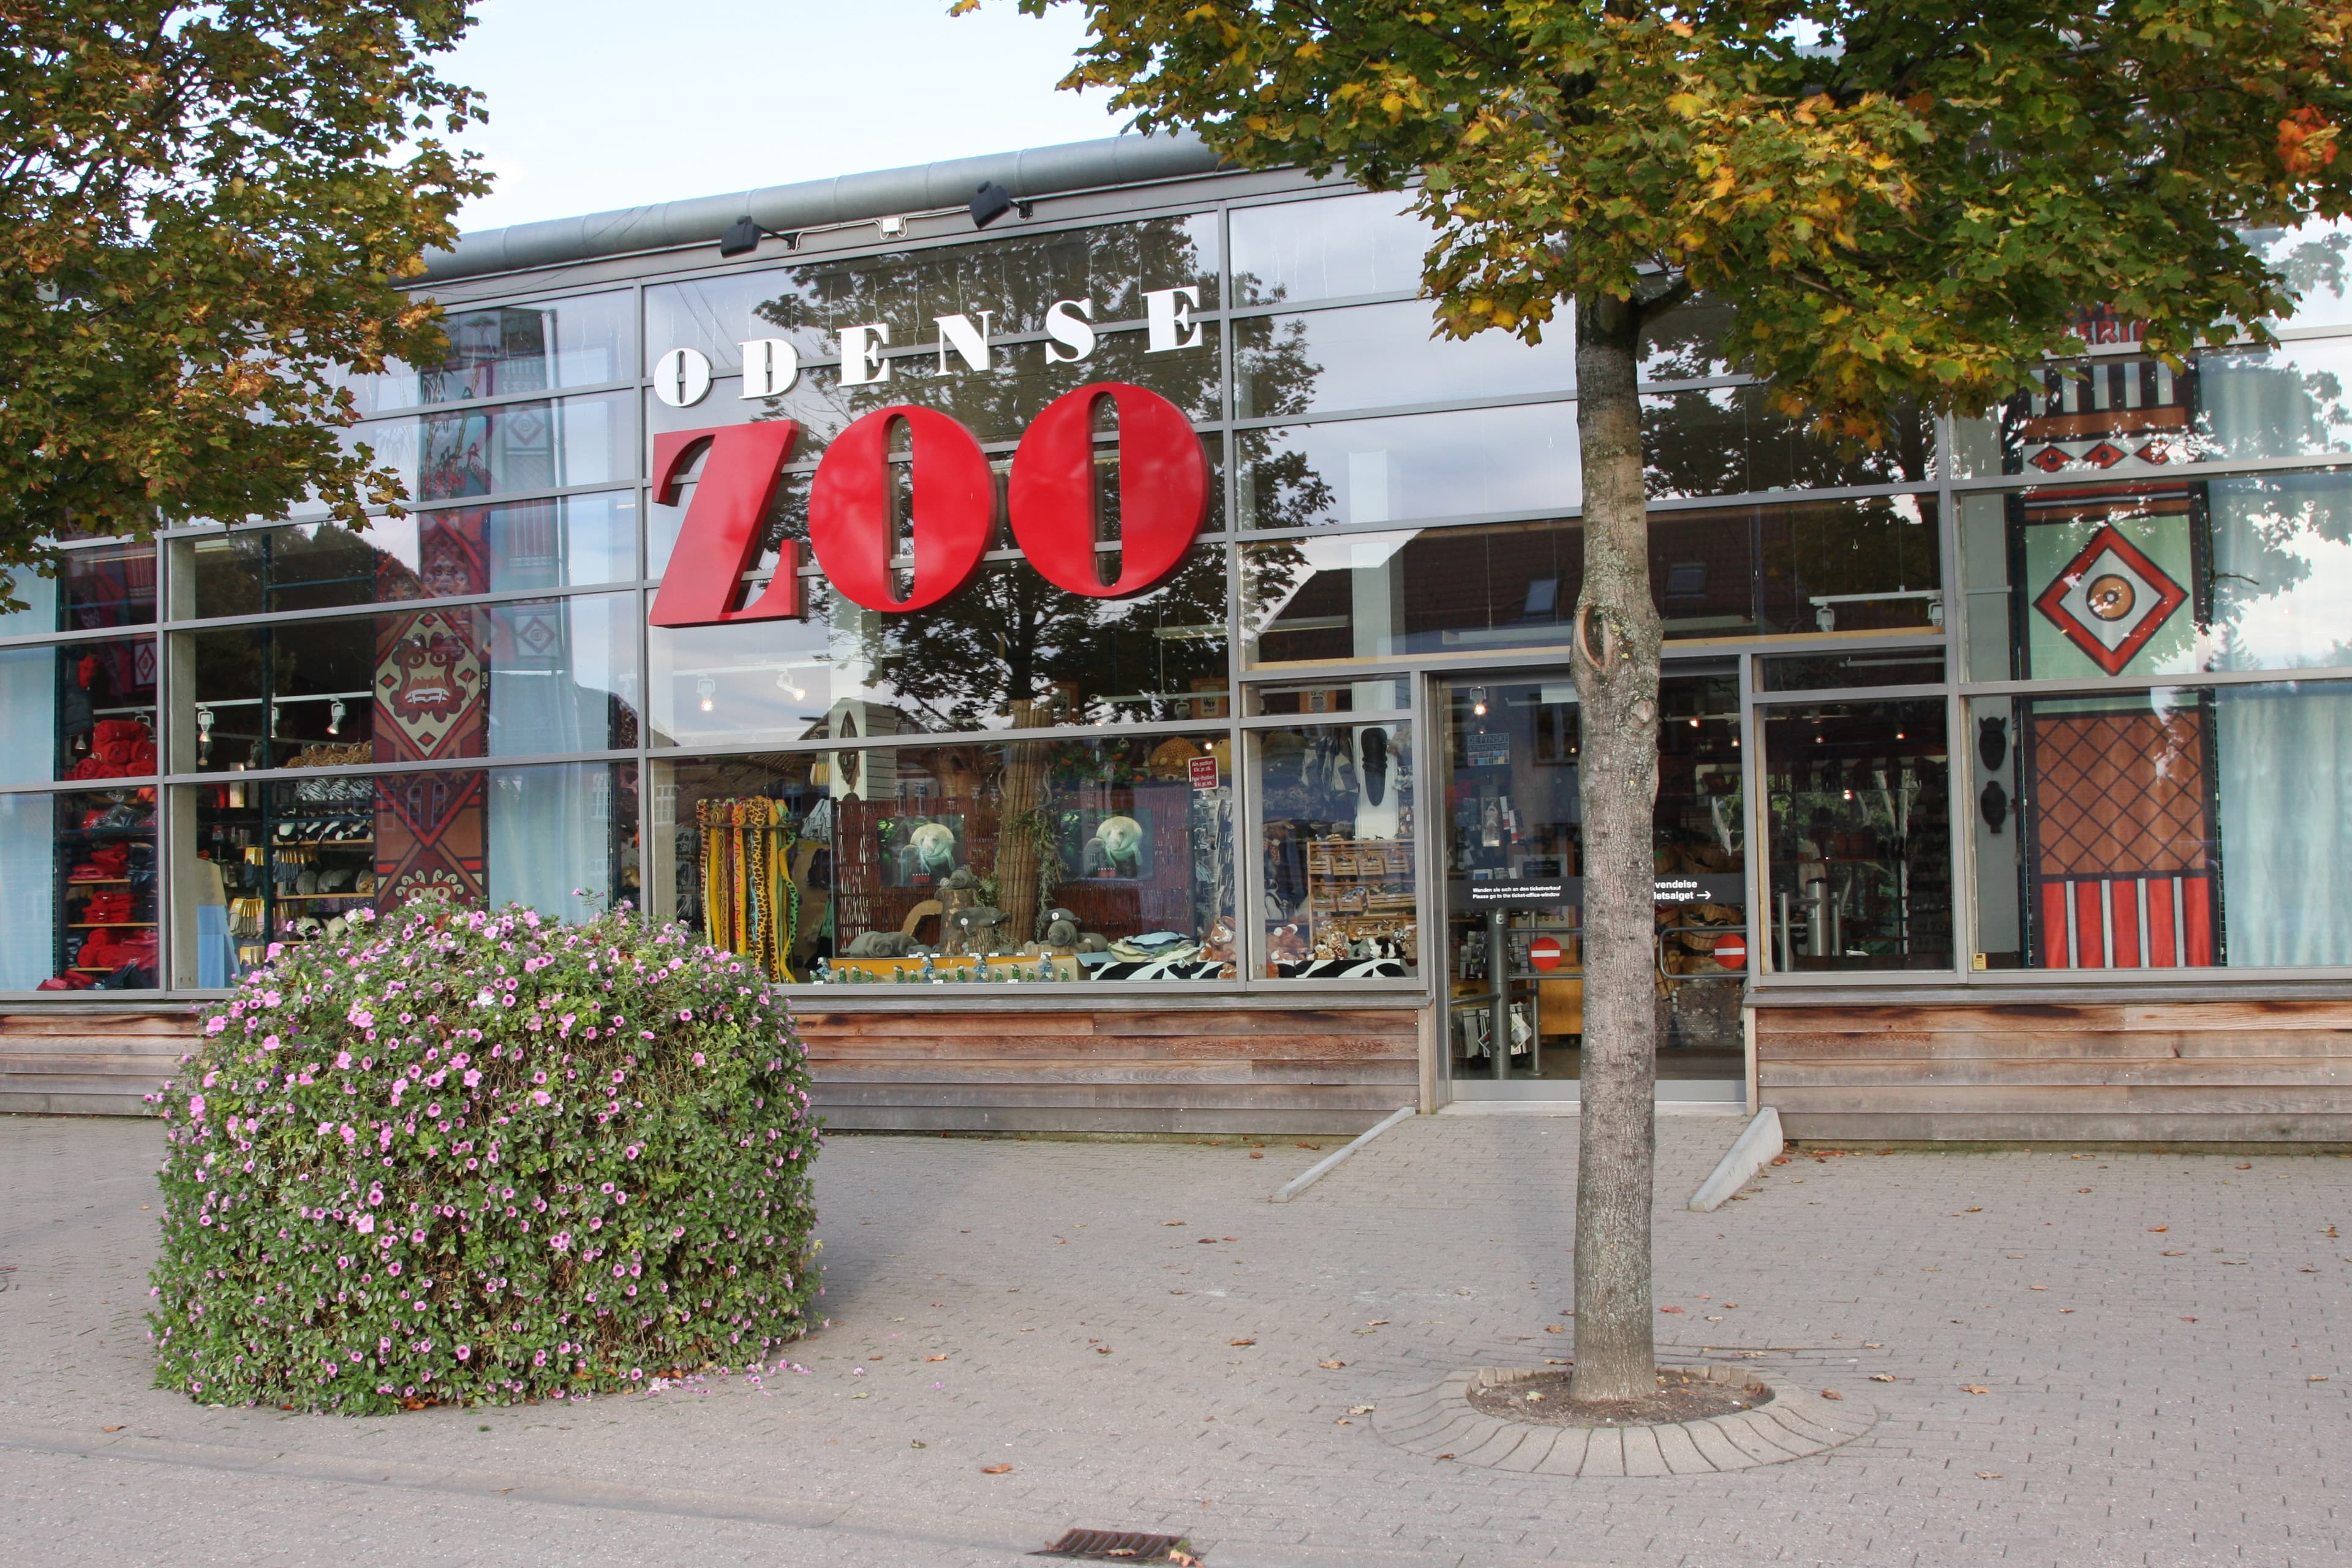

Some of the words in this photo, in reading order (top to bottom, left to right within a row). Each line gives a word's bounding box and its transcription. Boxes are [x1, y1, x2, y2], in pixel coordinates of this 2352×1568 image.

[654, 285, 1202, 407] ODENSE
[649, 381, 1209, 627] ZOO
[1480, 734, 1509, 744] FYNSKE
